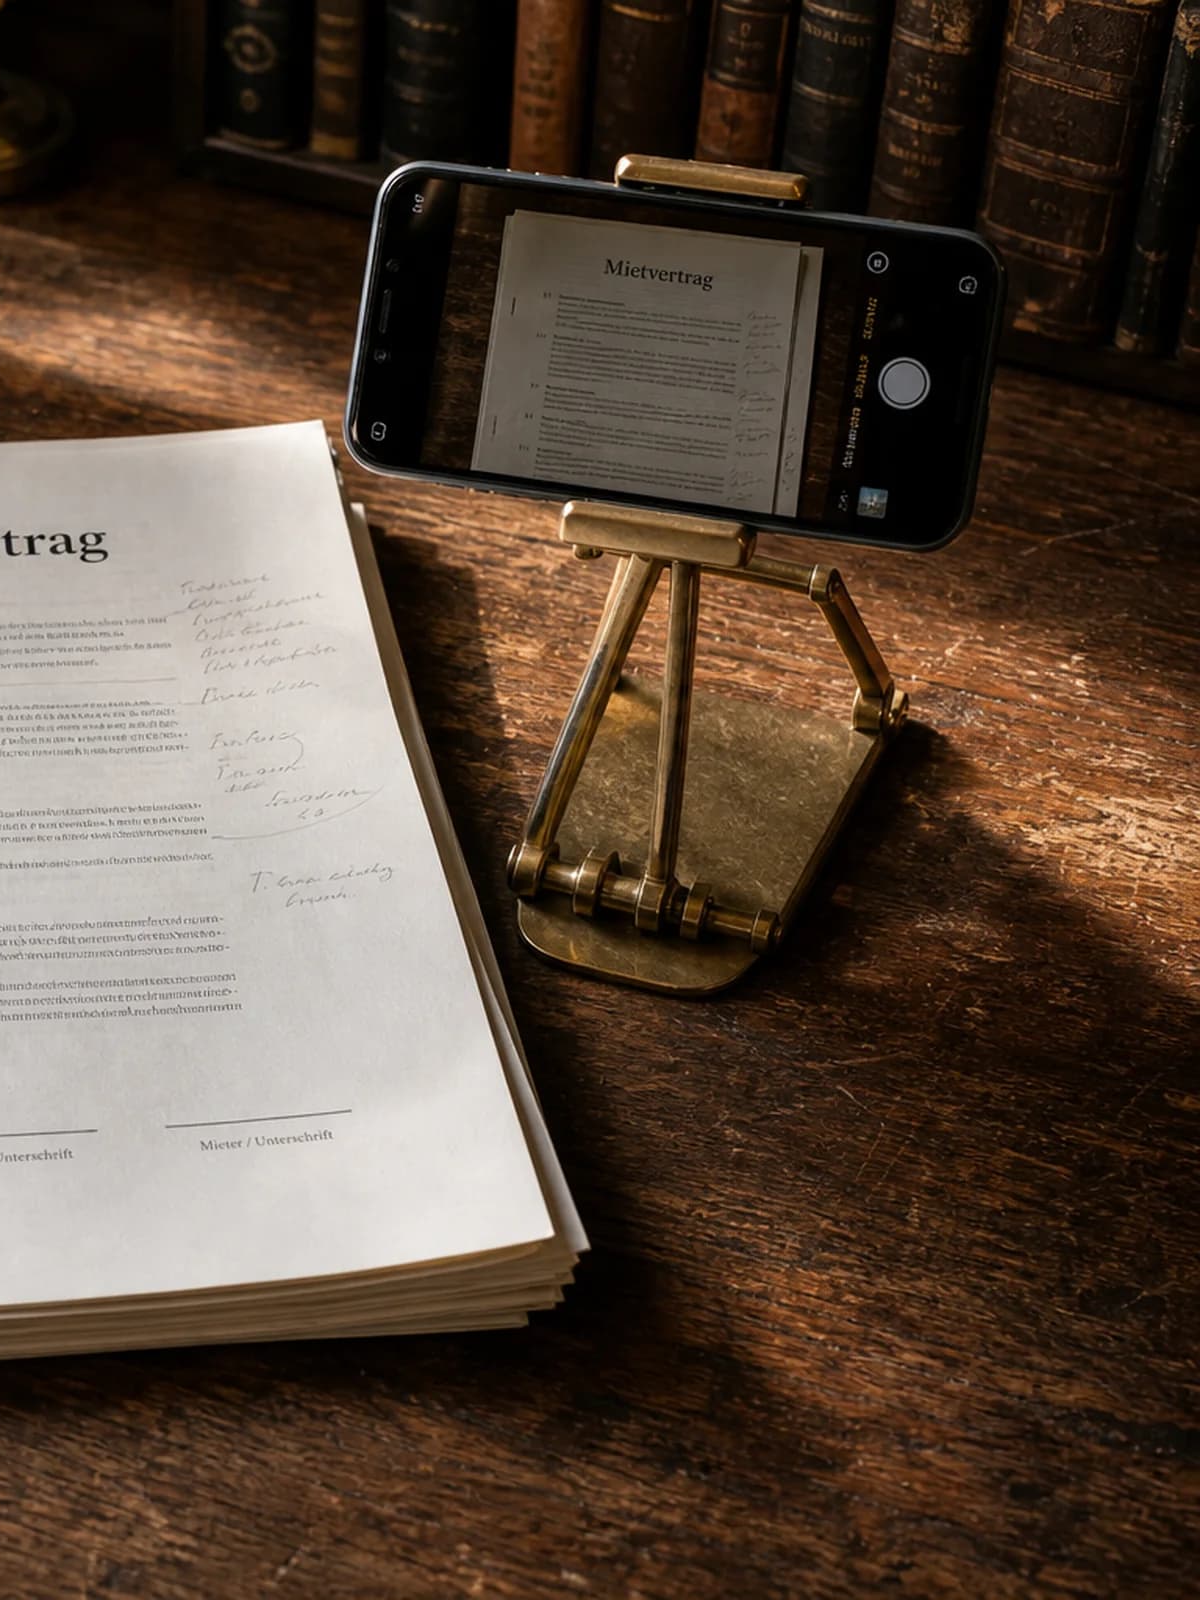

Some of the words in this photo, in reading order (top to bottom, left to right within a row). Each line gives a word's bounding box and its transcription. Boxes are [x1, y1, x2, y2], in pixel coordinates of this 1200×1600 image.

[603, 258, 714, 291] Mietvertrag
[199, 1138, 243, 1152] Mieter
[246, 1136, 252, 1148] /
[254, 1129, 334, 1147] Unterschrift
